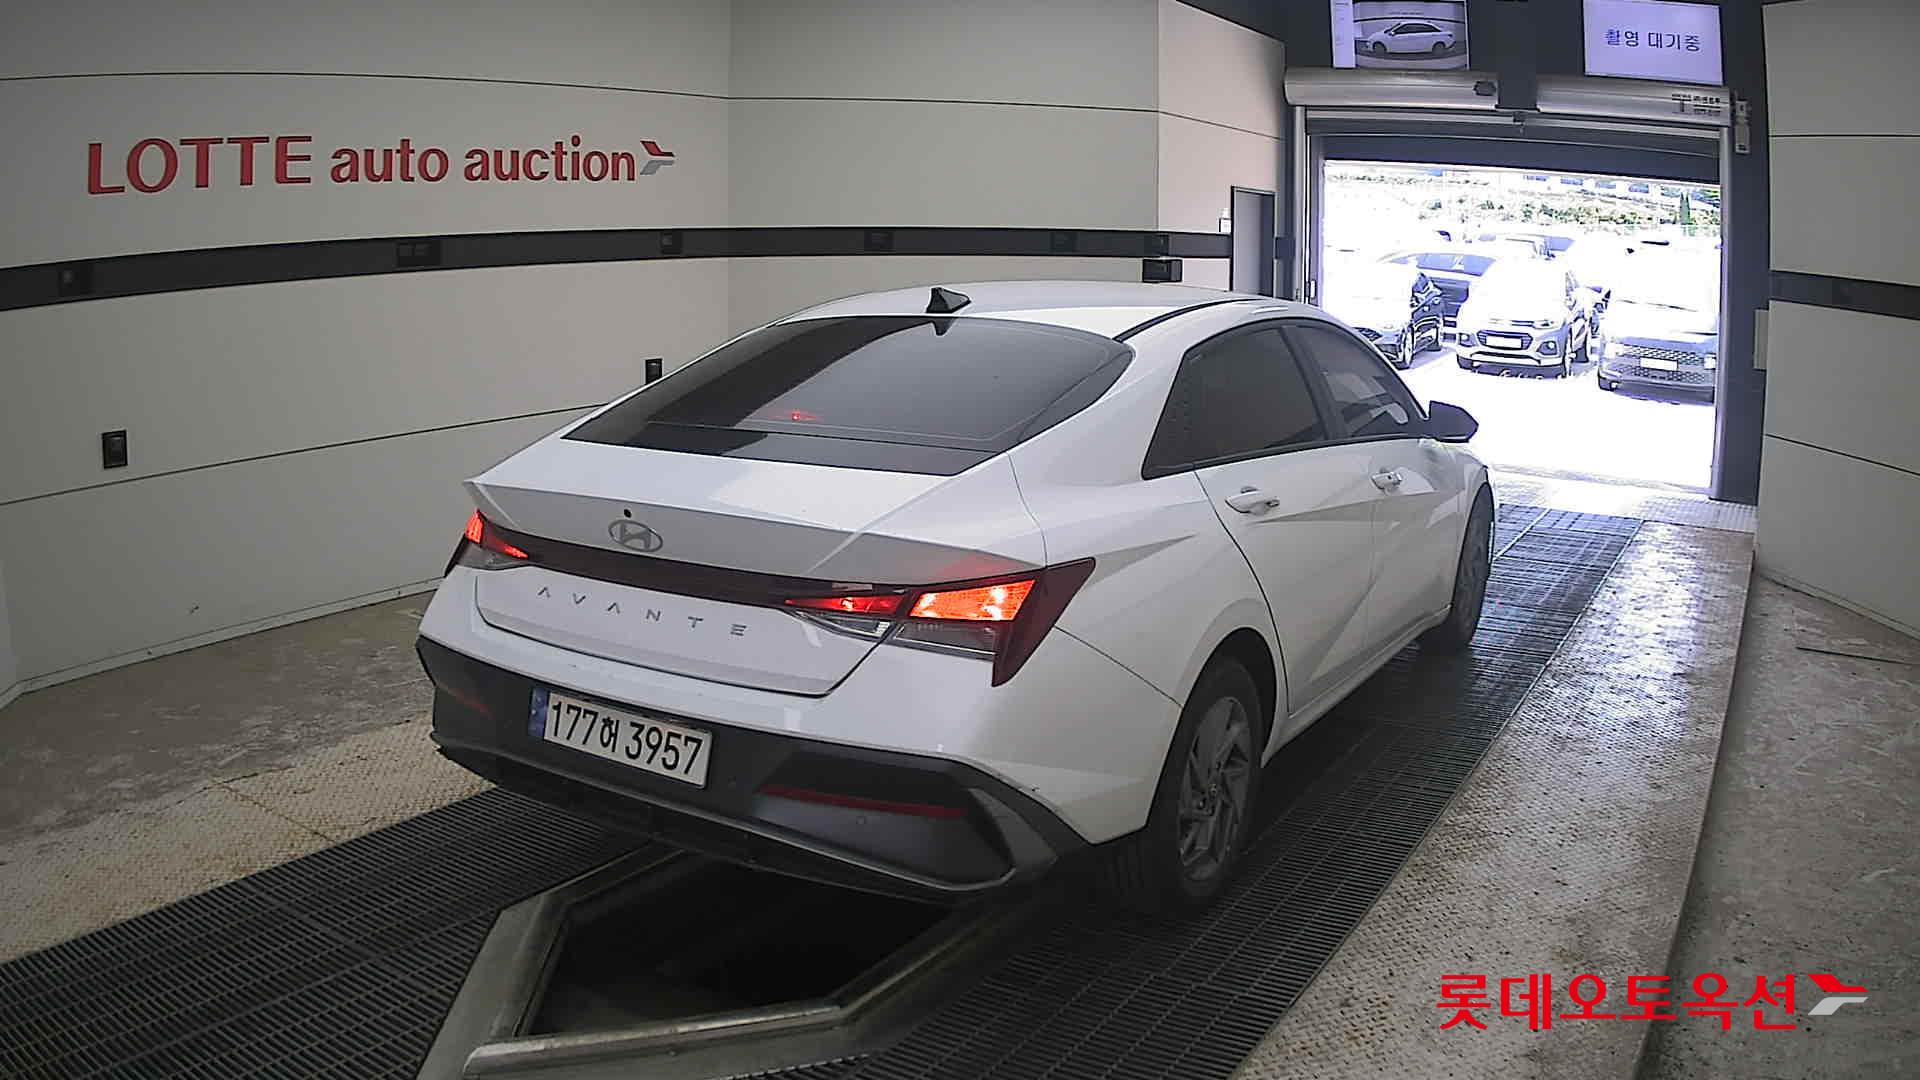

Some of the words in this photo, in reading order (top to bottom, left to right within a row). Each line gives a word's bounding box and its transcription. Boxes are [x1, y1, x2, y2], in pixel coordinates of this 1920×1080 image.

[1647, 31, 1701, 52] 대기중
[87, 135, 313, 194] LOTTE
[329, 138, 450, 182] auto
[463, 134, 637, 182] auction
[537, 585, 747, 637] AVANTE
[625, 721, 703, 776] 3957
